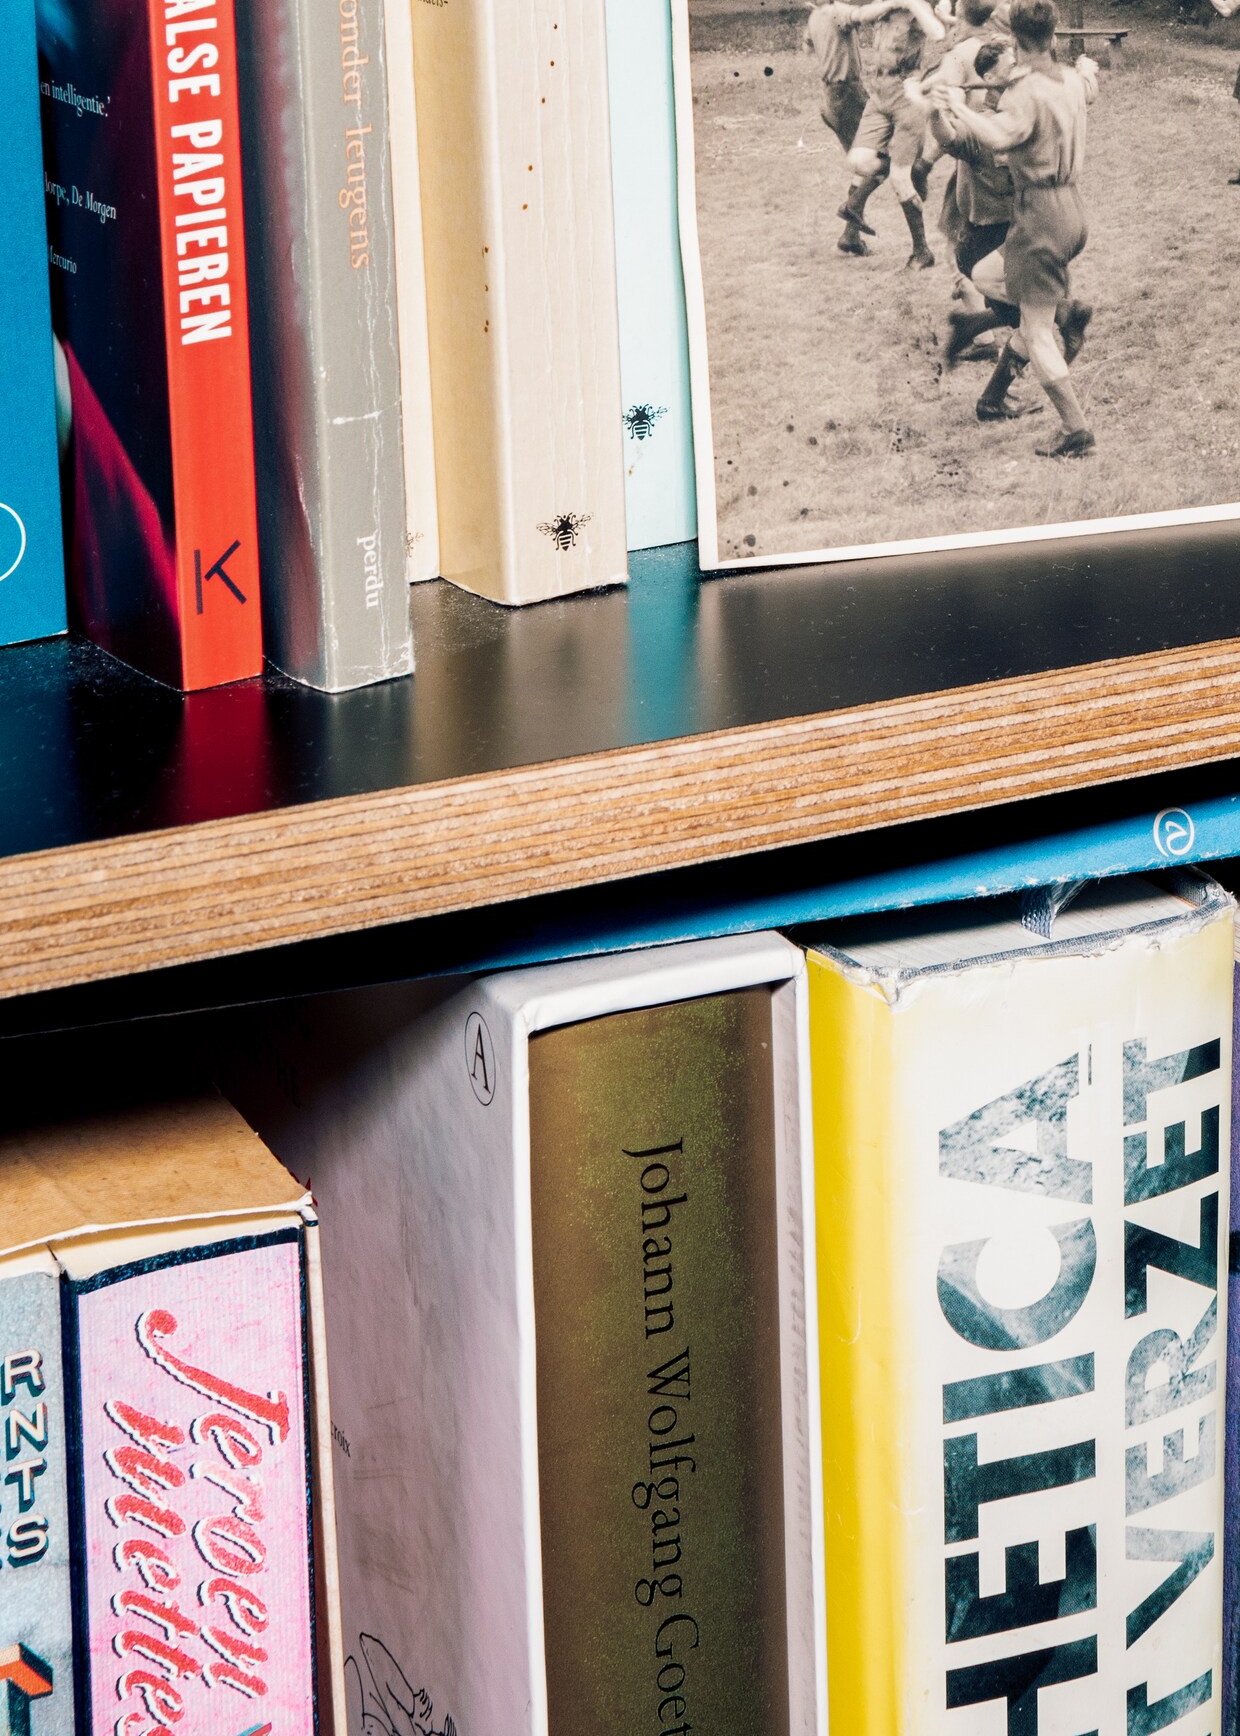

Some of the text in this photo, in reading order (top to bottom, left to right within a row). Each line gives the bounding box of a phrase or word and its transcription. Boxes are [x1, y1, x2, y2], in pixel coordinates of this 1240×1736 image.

[84, 190, 117, 224] Morgen
[170, 118, 233, 348] PAPIEREN
[338, 125, 372, 270] leugens
[357, 532, 379, 609] perdu
[620, 1137, 688, 1341] Johann
[1124, 1036, 1222, 1651] VERZET
[135, 1308, 290, 1699] Jeroen
[630, 1346, 698, 1610] Wolfgang
